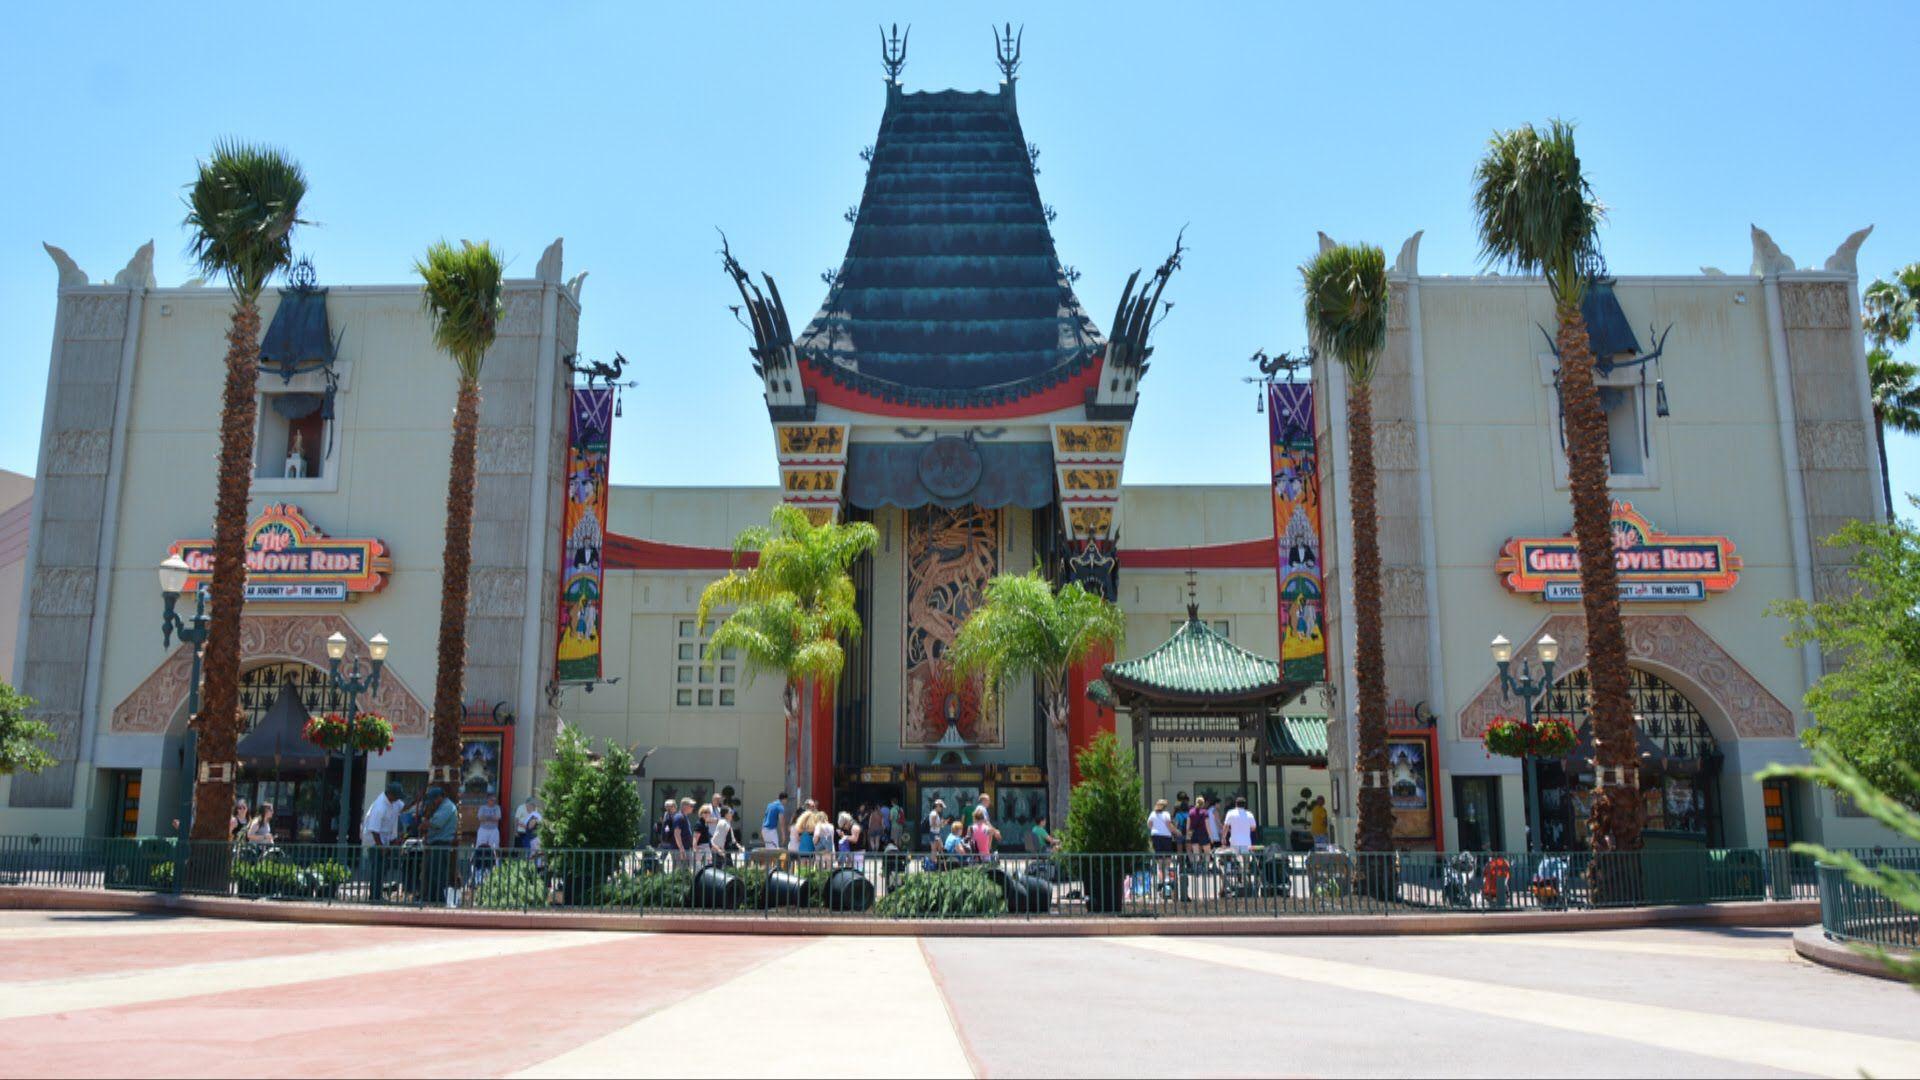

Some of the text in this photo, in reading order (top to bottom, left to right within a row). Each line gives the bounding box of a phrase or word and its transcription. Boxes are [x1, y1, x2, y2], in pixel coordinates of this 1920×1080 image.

[256, 527, 290, 551] The
[246, 551, 360, 571] MOVIE RIDE
[1614, 551, 1661, 570] OVIE
[1662, 548, 1716, 570] RIDE
[301, 587, 312, 595] THE
[315, 587, 338, 595] MOVIES
[1651, 586, 1663, 594] THE
[1666, 586, 1690, 594] MOVIES
